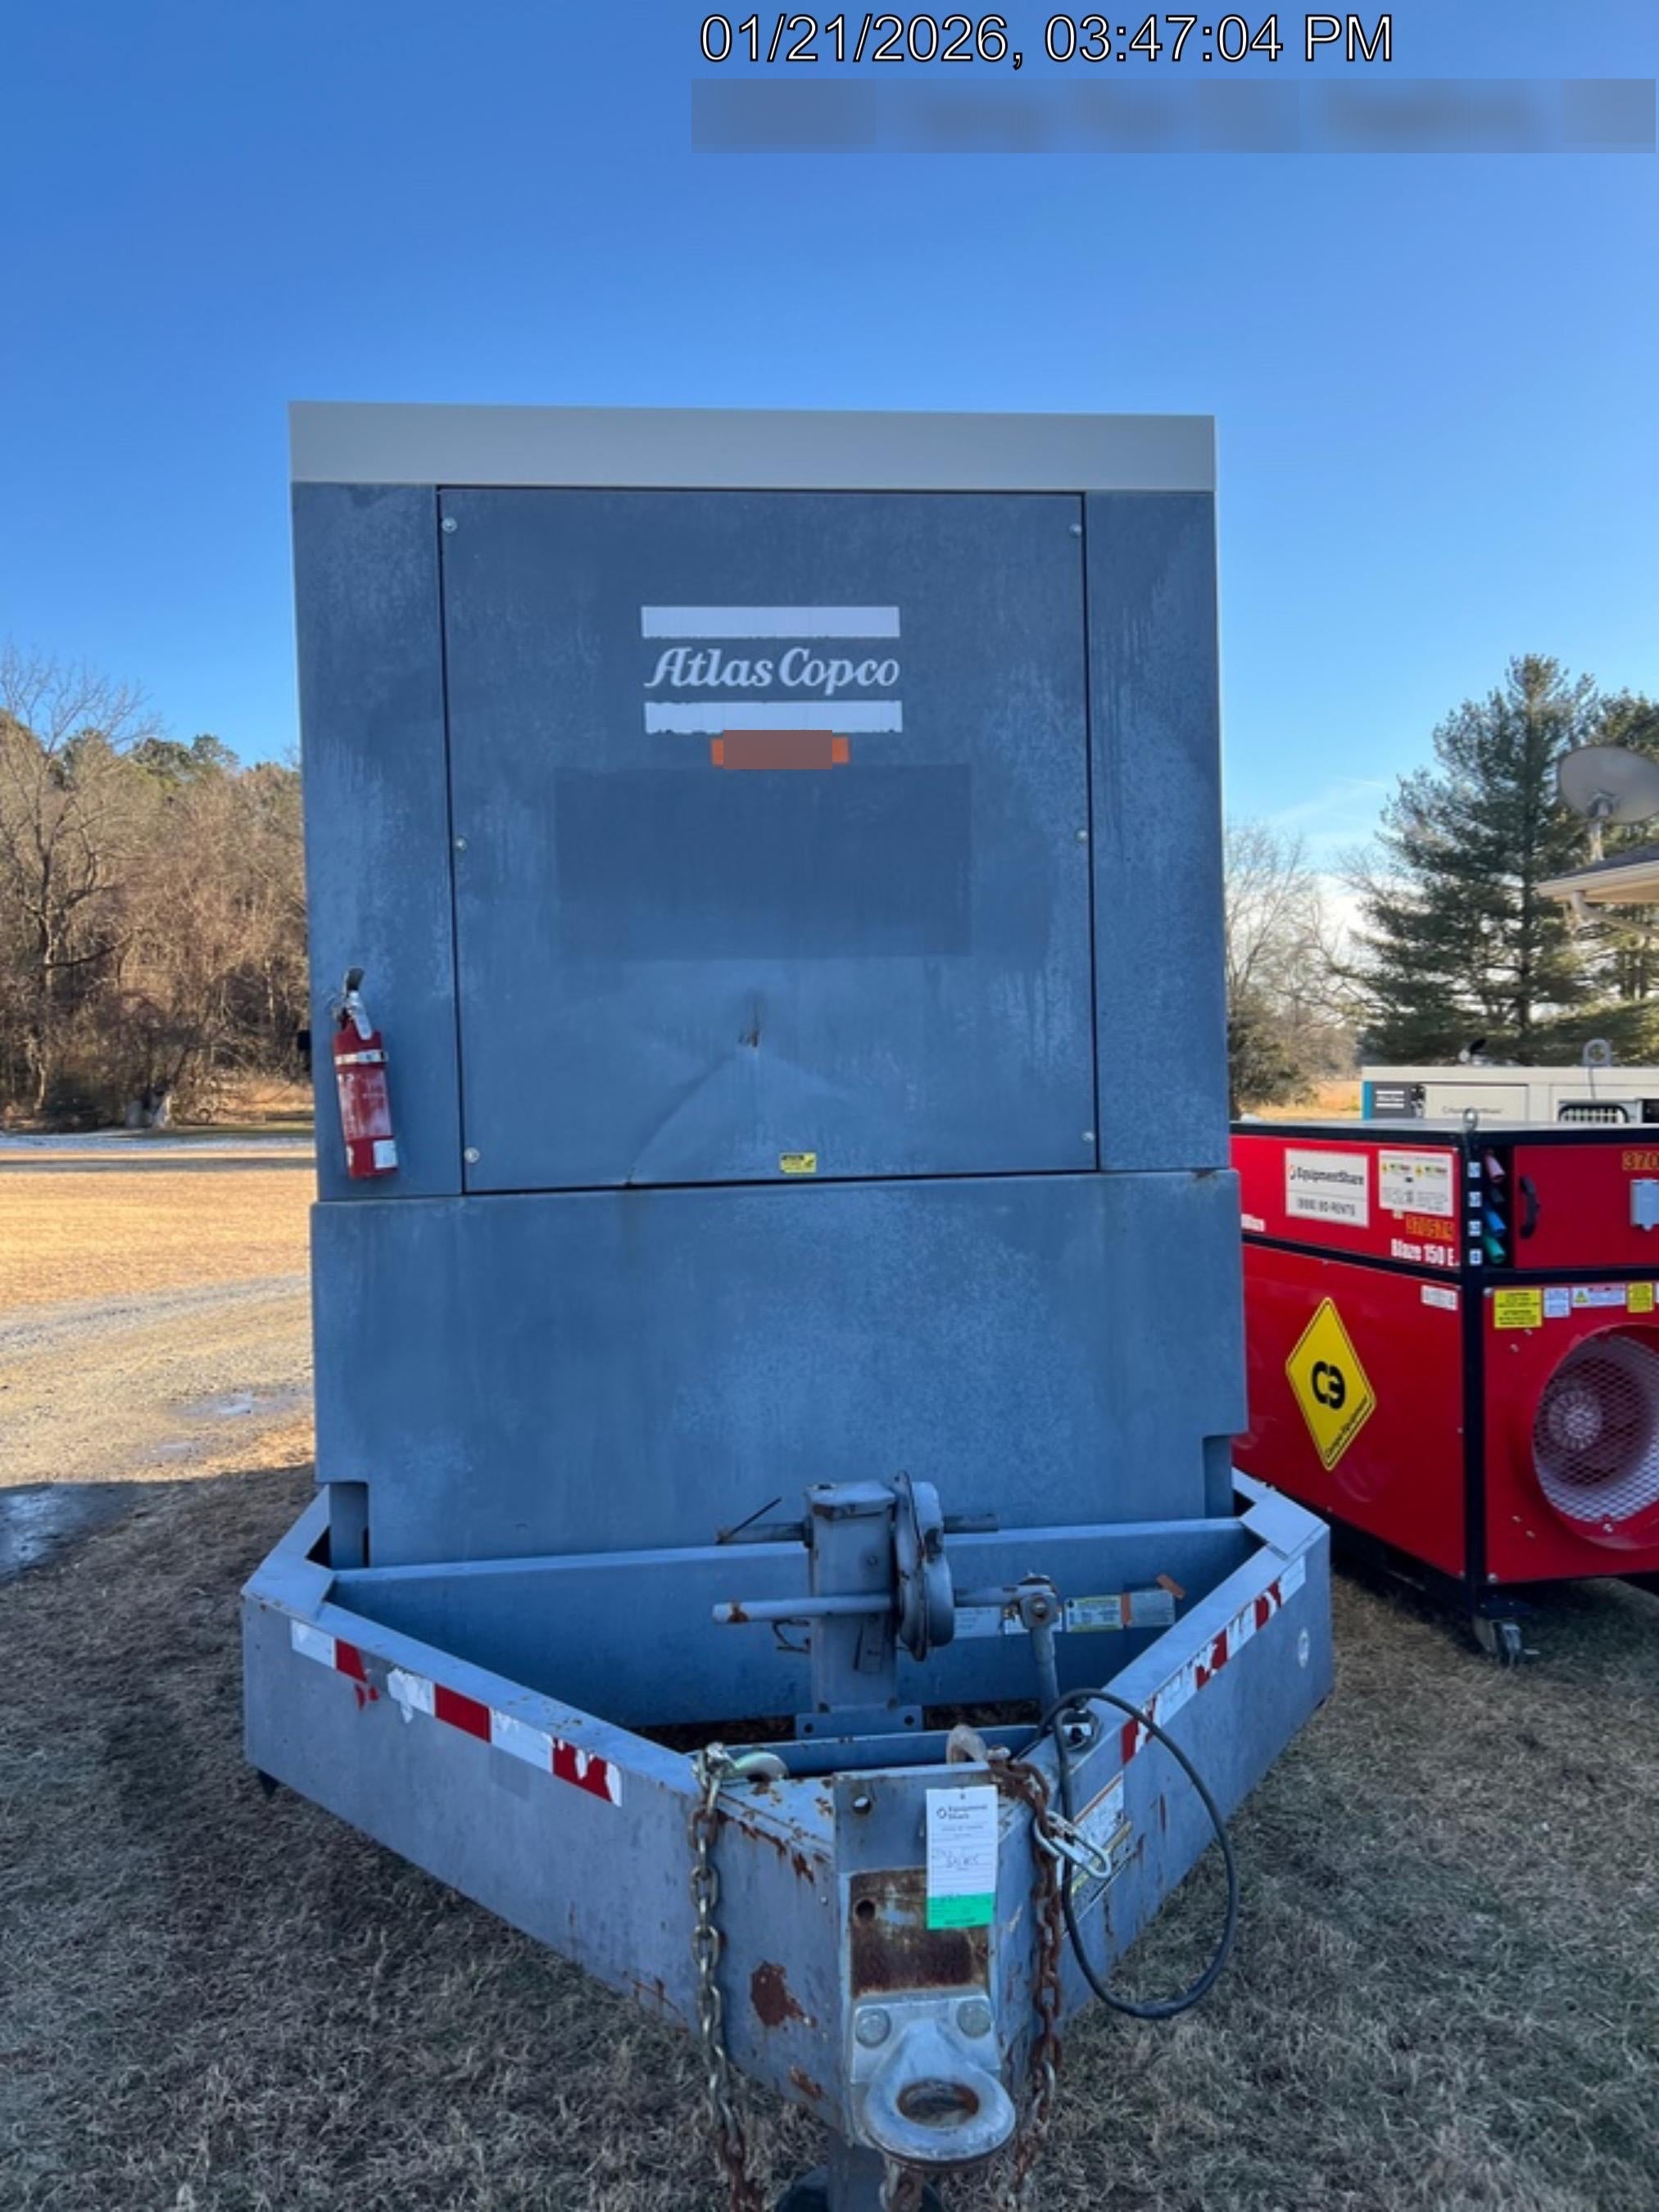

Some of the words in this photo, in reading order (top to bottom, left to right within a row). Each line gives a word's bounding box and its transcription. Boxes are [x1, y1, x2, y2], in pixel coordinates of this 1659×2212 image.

[644, 646, 773, 687] Atlas
[779, 646, 900, 696] Copco
[1297, 1166, 1364, 1185] EquipmentShare
[1391, 1238, 1421, 1261] Blaze
[1424, 1244, 1444, 1265] 150
